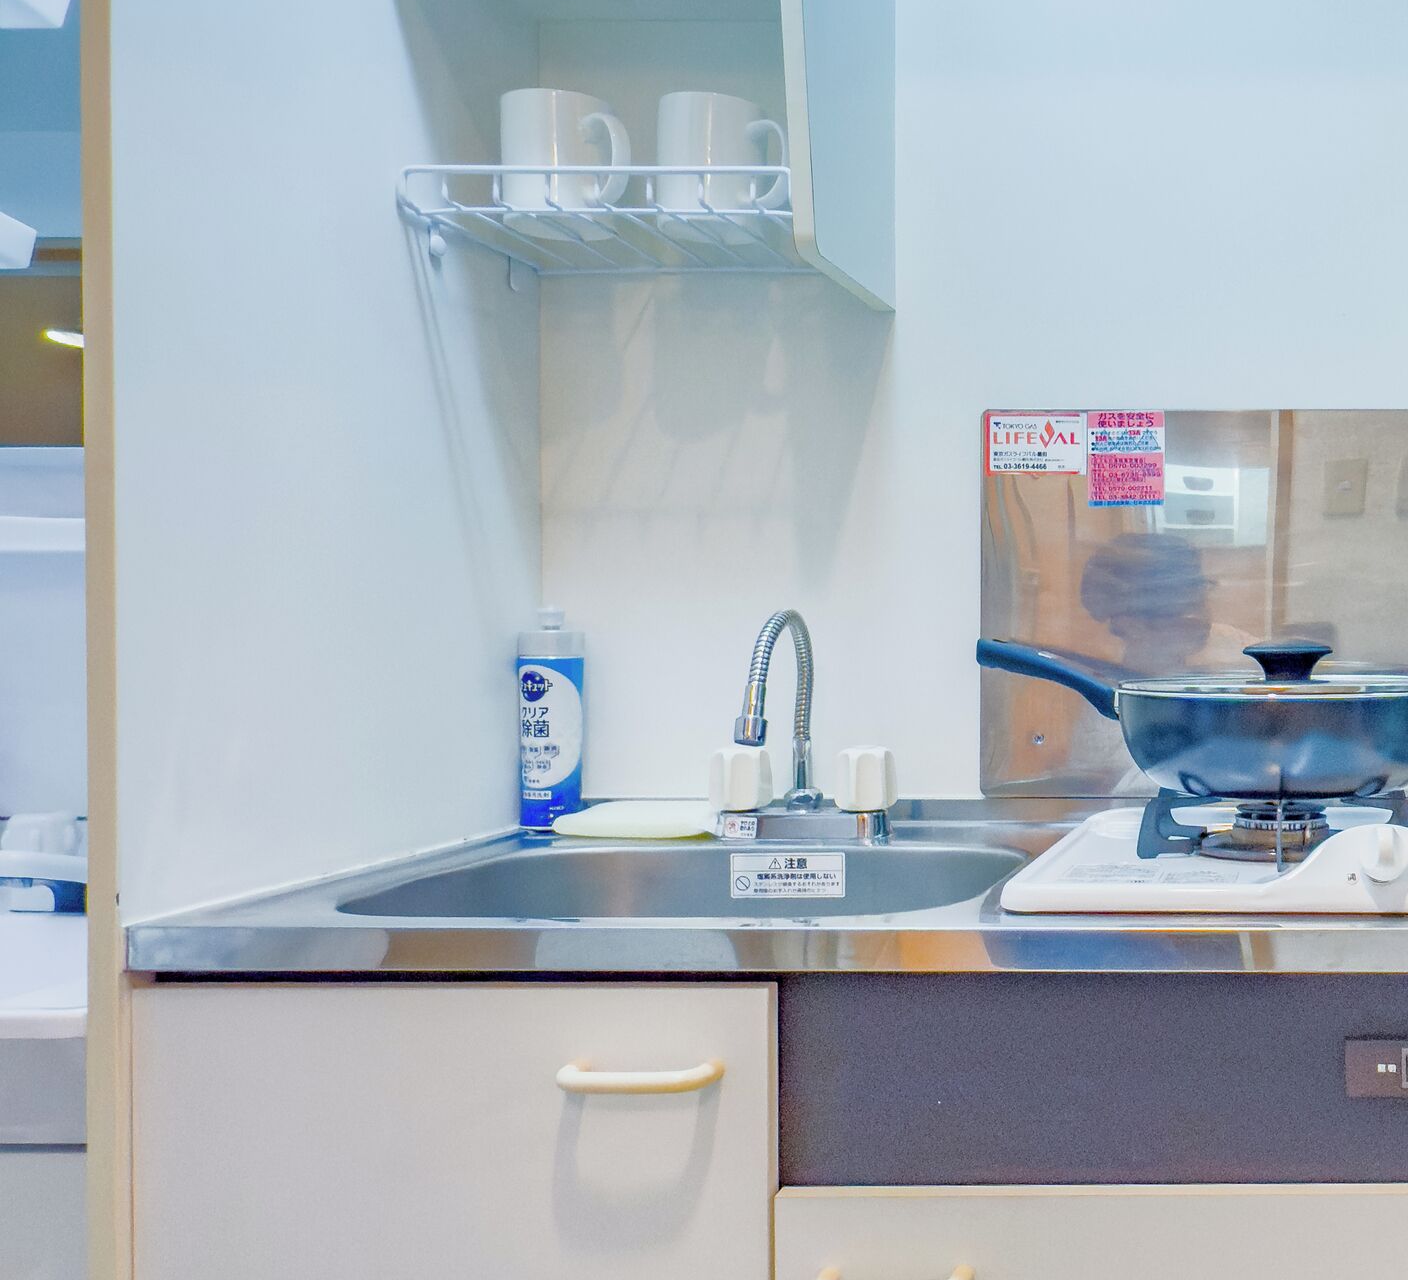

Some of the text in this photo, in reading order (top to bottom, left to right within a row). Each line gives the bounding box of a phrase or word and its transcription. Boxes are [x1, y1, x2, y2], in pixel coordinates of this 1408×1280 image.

[1098, 412, 1154, 420] ガスを安全に
[522, 707, 549, 719] クリア
[522, 719, 549, 738] 除菌
[784, 858, 808, 869] 注意
